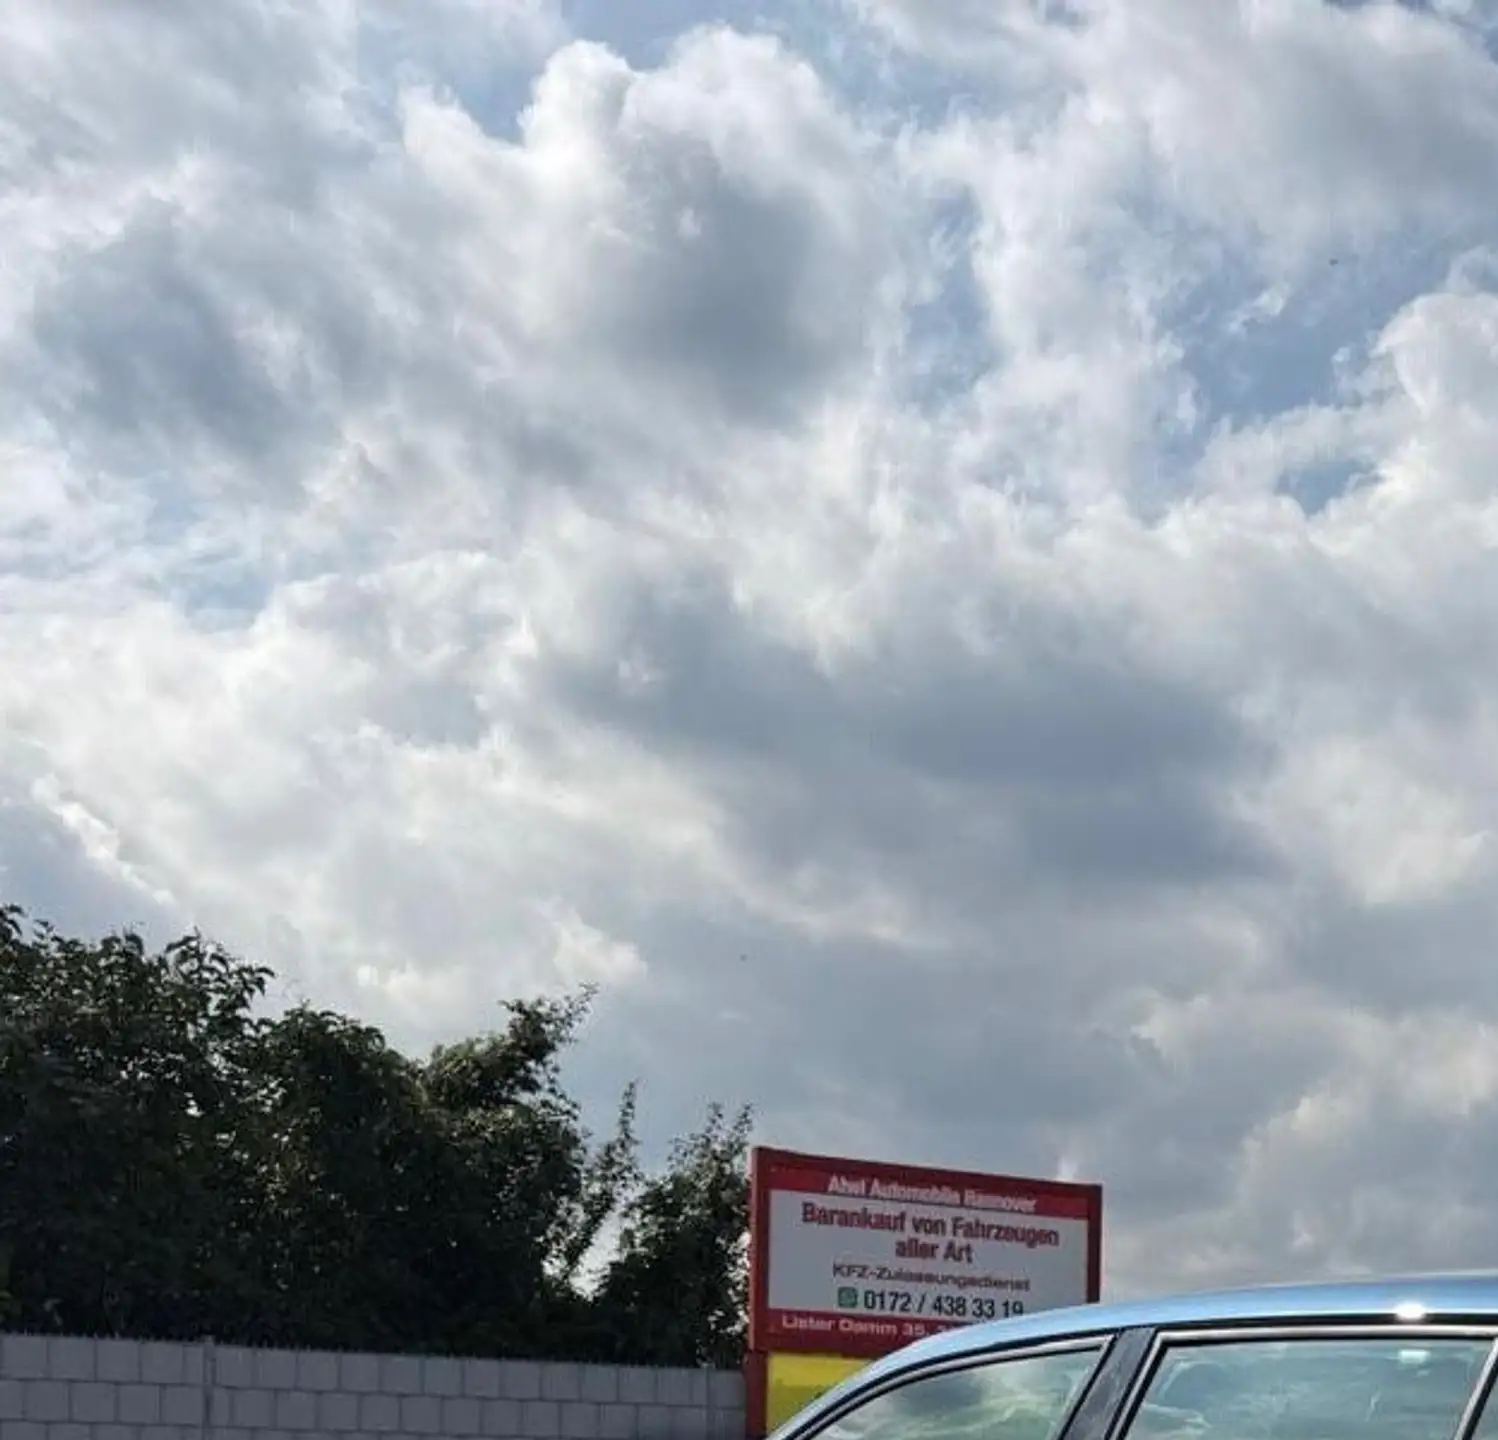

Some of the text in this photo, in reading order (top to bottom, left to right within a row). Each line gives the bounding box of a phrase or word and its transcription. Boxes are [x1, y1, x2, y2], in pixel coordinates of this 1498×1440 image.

[802, 1202, 1060, 1248] Barankauf von Fahrzeugen
[895, 1238, 973, 1264] aller Art
[863, 1291, 1024, 1319] 0172 / 438 33 19
[781, 1315, 833, 1332] Lister
[839, 1318, 898, 1336] Damm
